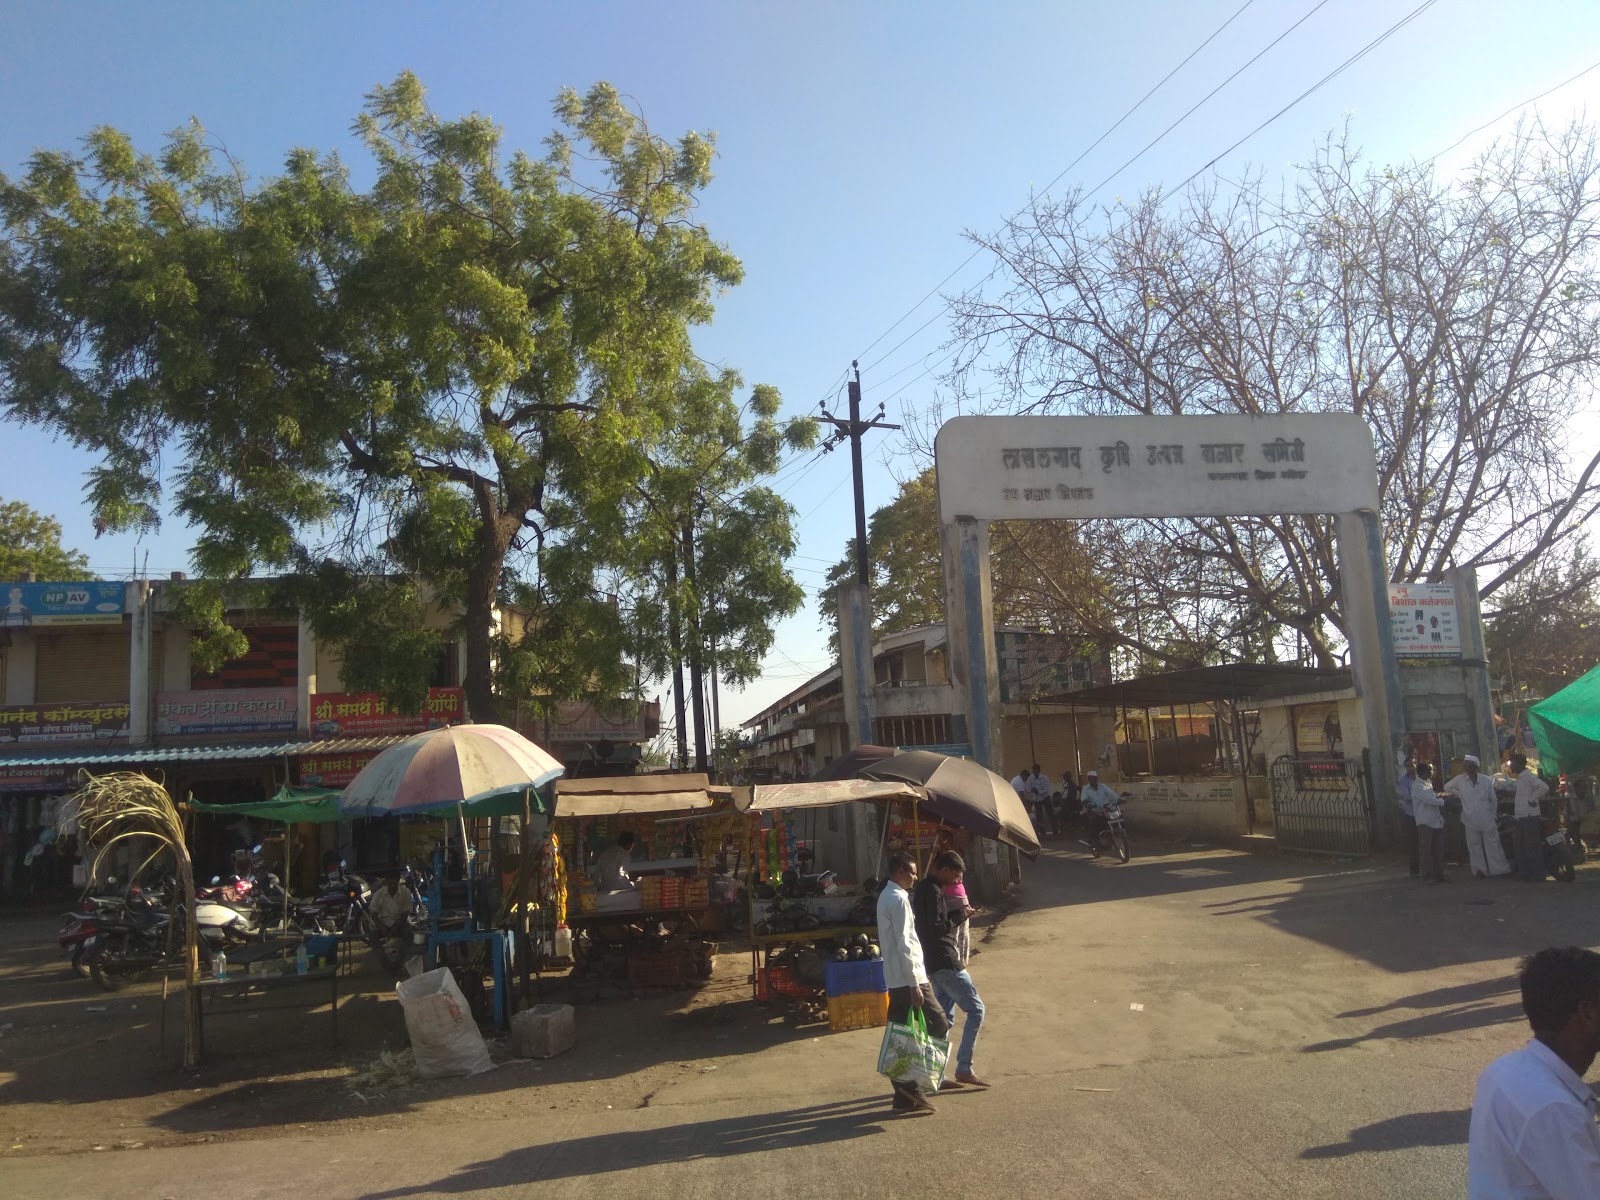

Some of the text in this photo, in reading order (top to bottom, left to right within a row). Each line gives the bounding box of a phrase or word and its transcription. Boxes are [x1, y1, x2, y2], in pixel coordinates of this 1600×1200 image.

[1099, 440, 1130, 473] कृषि
[1200, 443, 1245, 464] बाजार
[1262, 437, 1305, 463] समिती
[46, 593, 86, 602] NP AV
[1391, 596, 1453, 606] विशाल कलेक्शन
[242, 697, 287, 713] कंपनी
[315, 700, 333, 720] श्री
[336, 697, 371, 717] समर्थ
[427, 693, 458, 714] शॉपी
[302, 759, 317, 773] श्री
[321, 756, 352, 771] समर्थ
